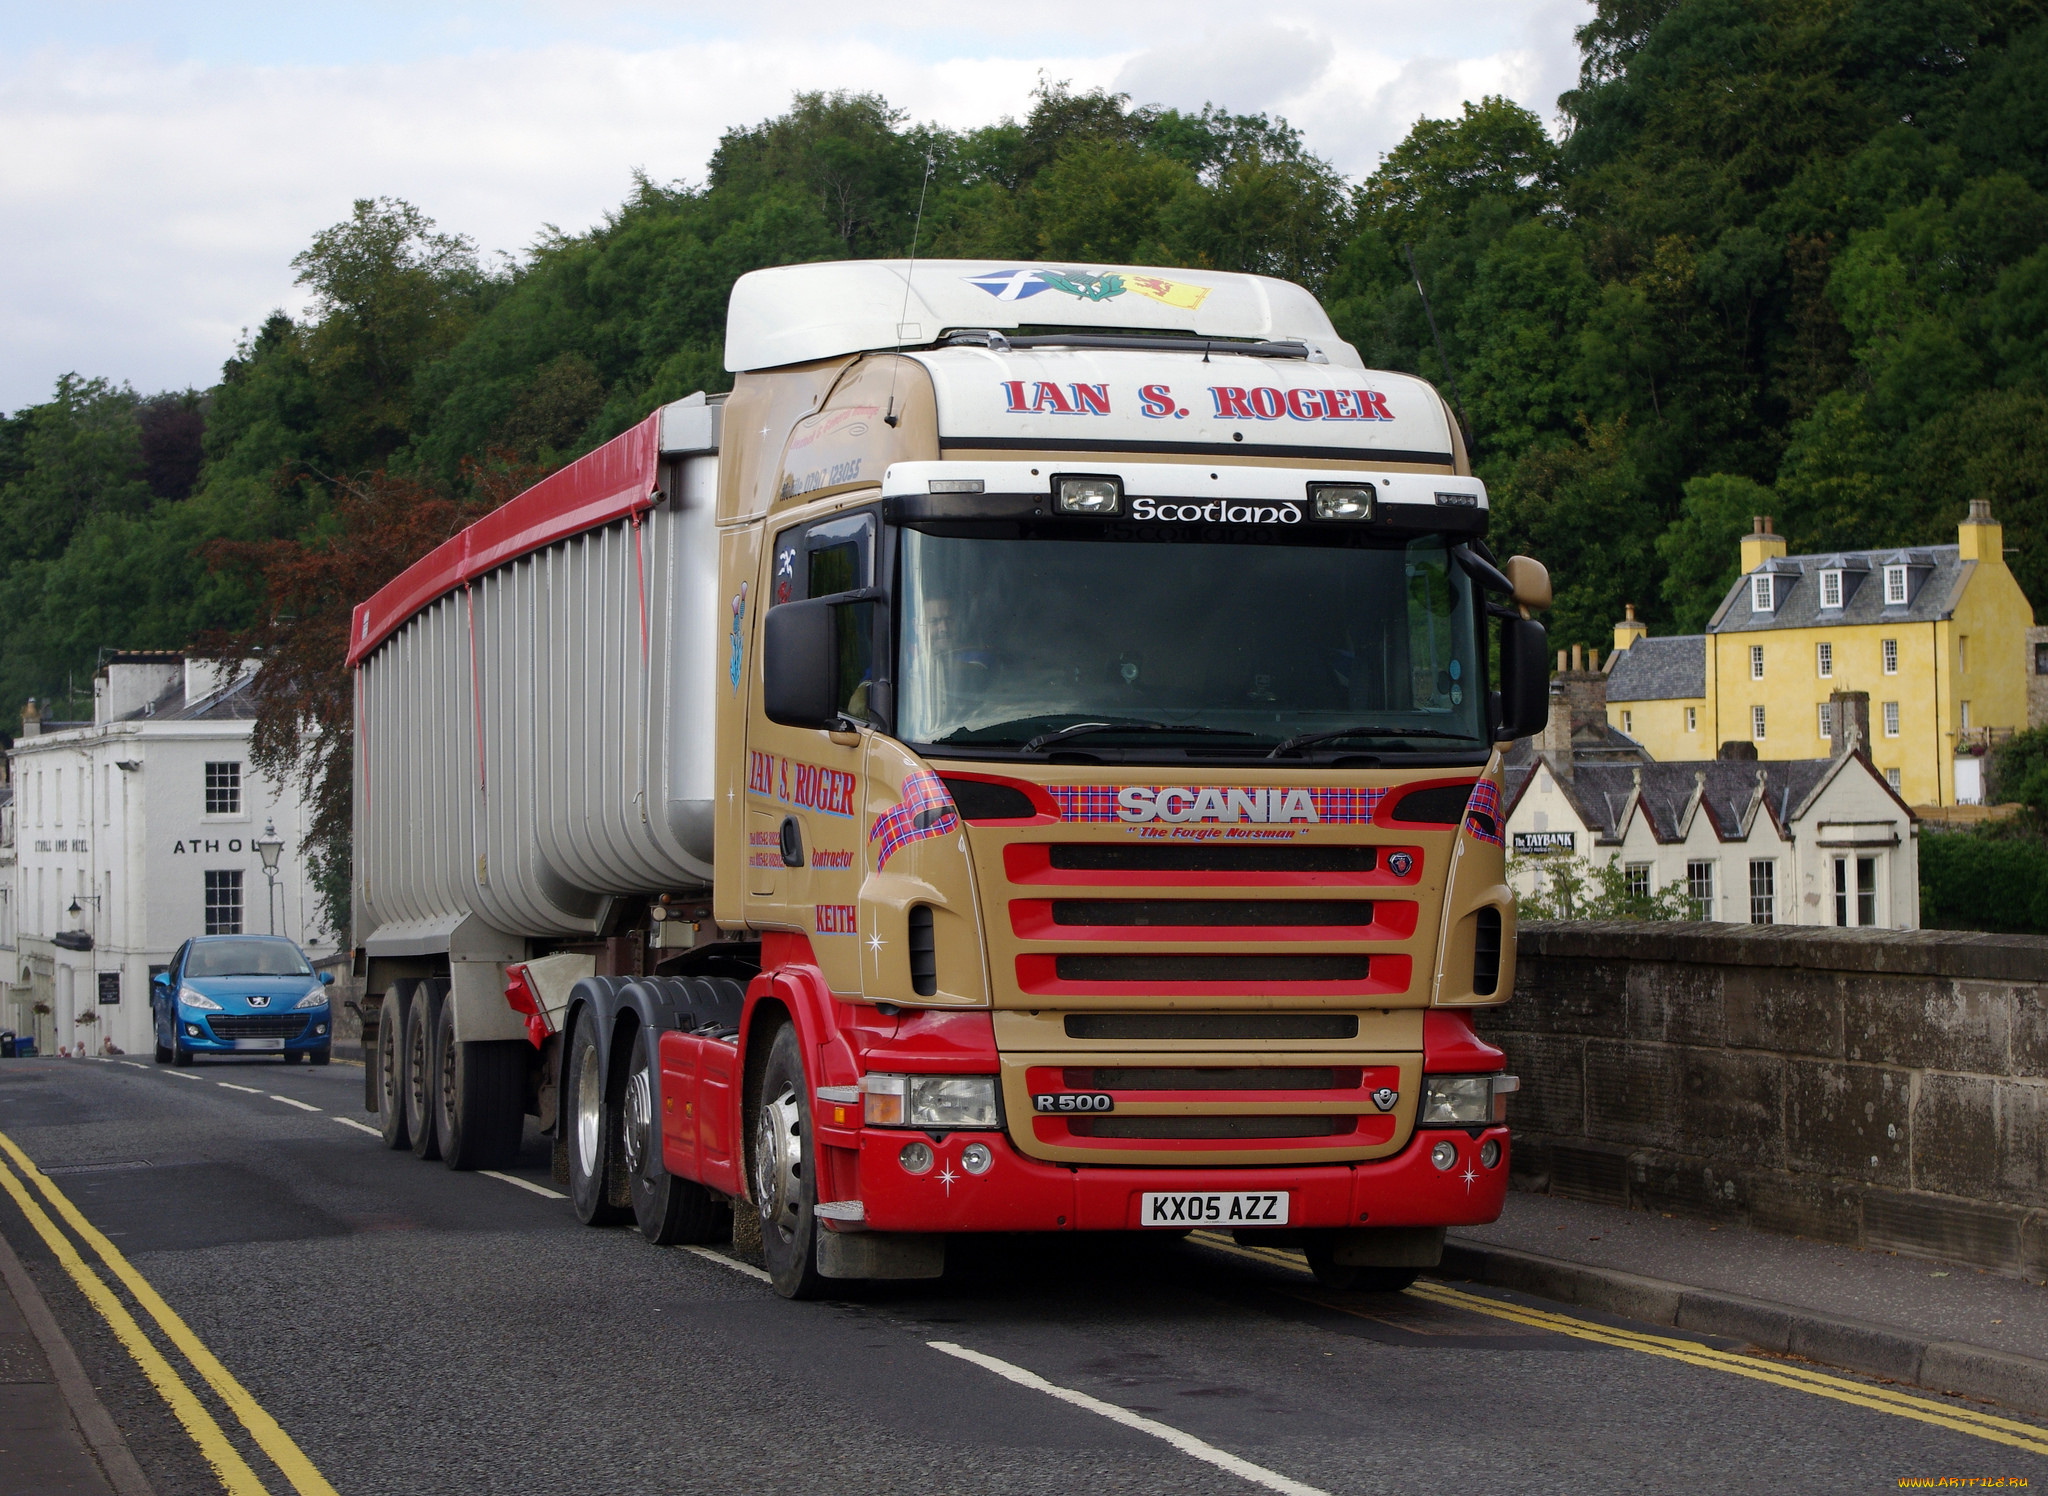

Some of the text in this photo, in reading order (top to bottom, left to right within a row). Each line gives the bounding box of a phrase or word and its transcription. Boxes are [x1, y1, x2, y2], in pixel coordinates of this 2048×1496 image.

[1001, 380, 1396, 422] IAN S. ROGER
[828, 458, 862, 486] 123055
[1133, 498, 1302, 525] Scotland
[748, 750, 857, 819] IAN S. ROGER
[1116, 787, 1320, 823] SCANIA
[173, 839, 285, 854] ATHOL
[1138, 827, 1296, 842] The Forgie Norsman
[1515, 833, 1572, 847] The TAYBANK
[815, 904, 857, 936] KEITH
[1037, 1095, 1111, 1111] R 500
[1152, 1196, 1278, 1221] KX05 AZZ
